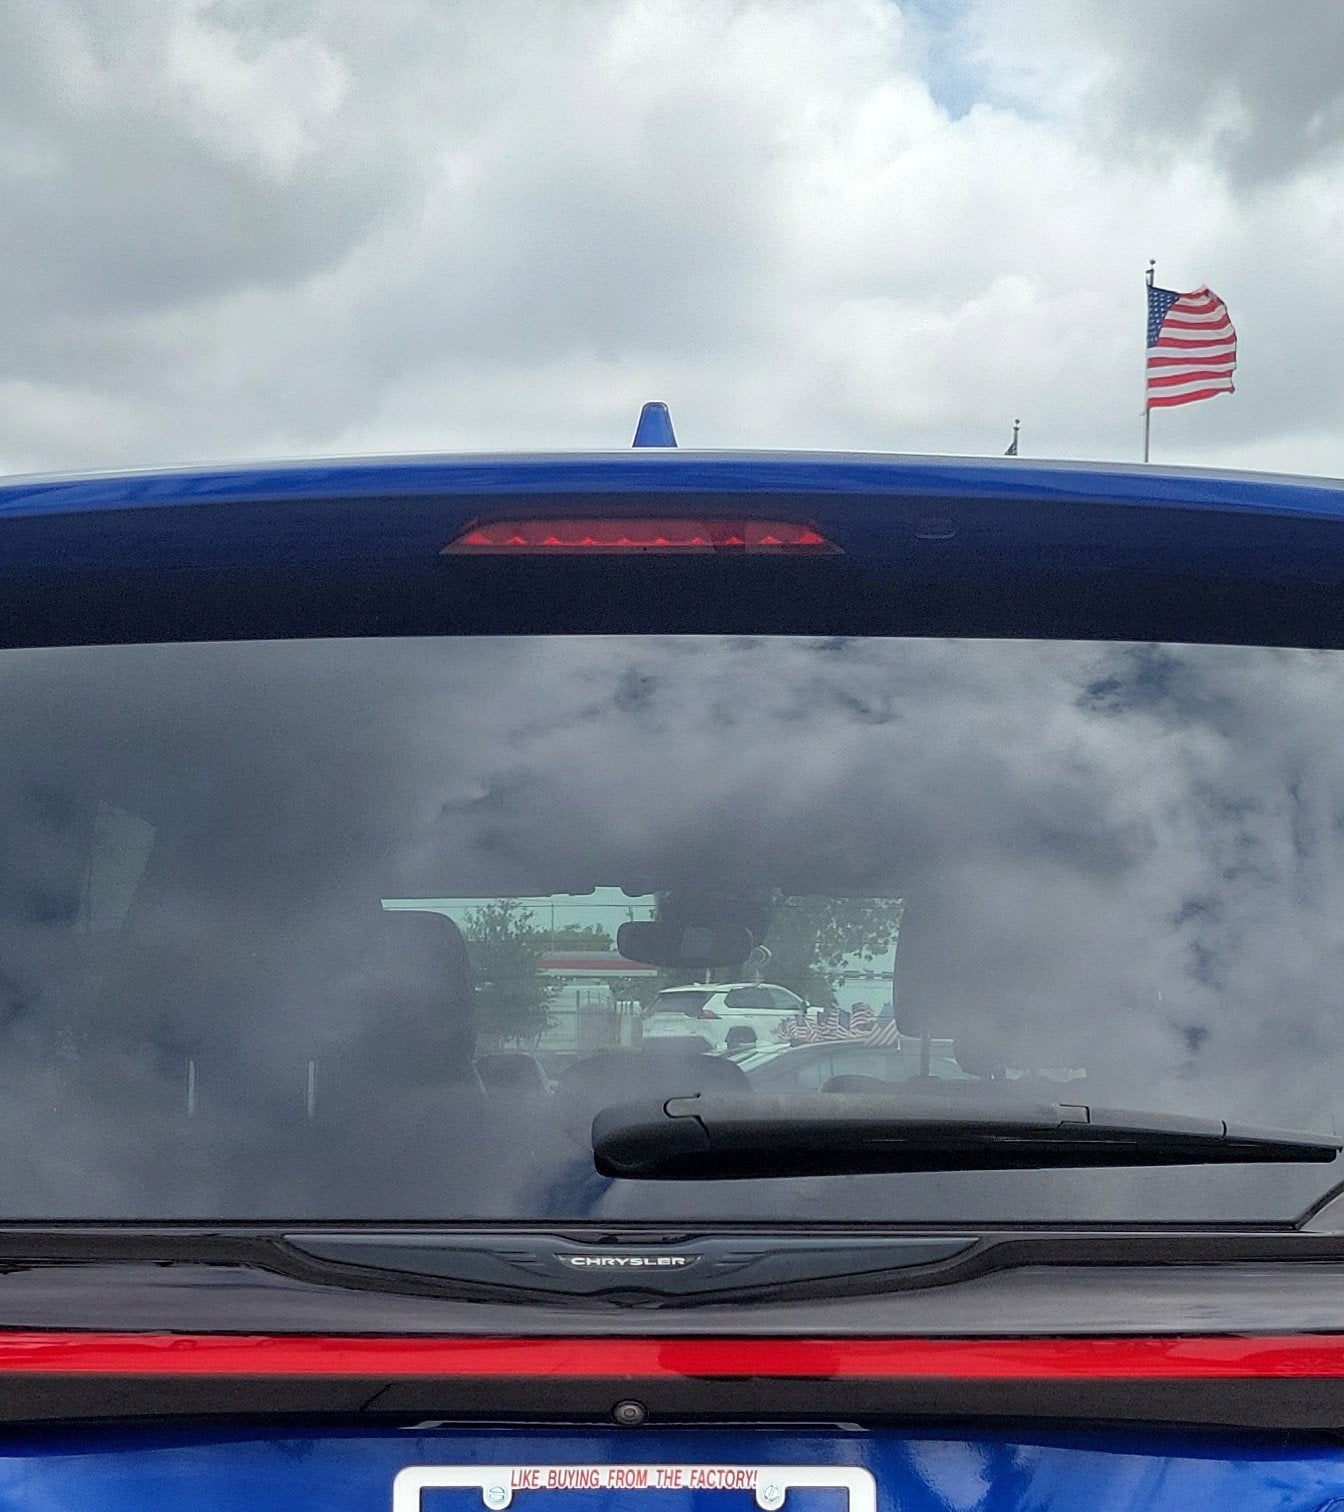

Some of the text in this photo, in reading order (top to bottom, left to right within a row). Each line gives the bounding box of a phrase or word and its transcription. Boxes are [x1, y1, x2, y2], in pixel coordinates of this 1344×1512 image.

[571, 1257, 686, 1266] CHRYSLER
[511, 1469, 758, 1487] LIKE BUYING FROM THE FACTORY!
